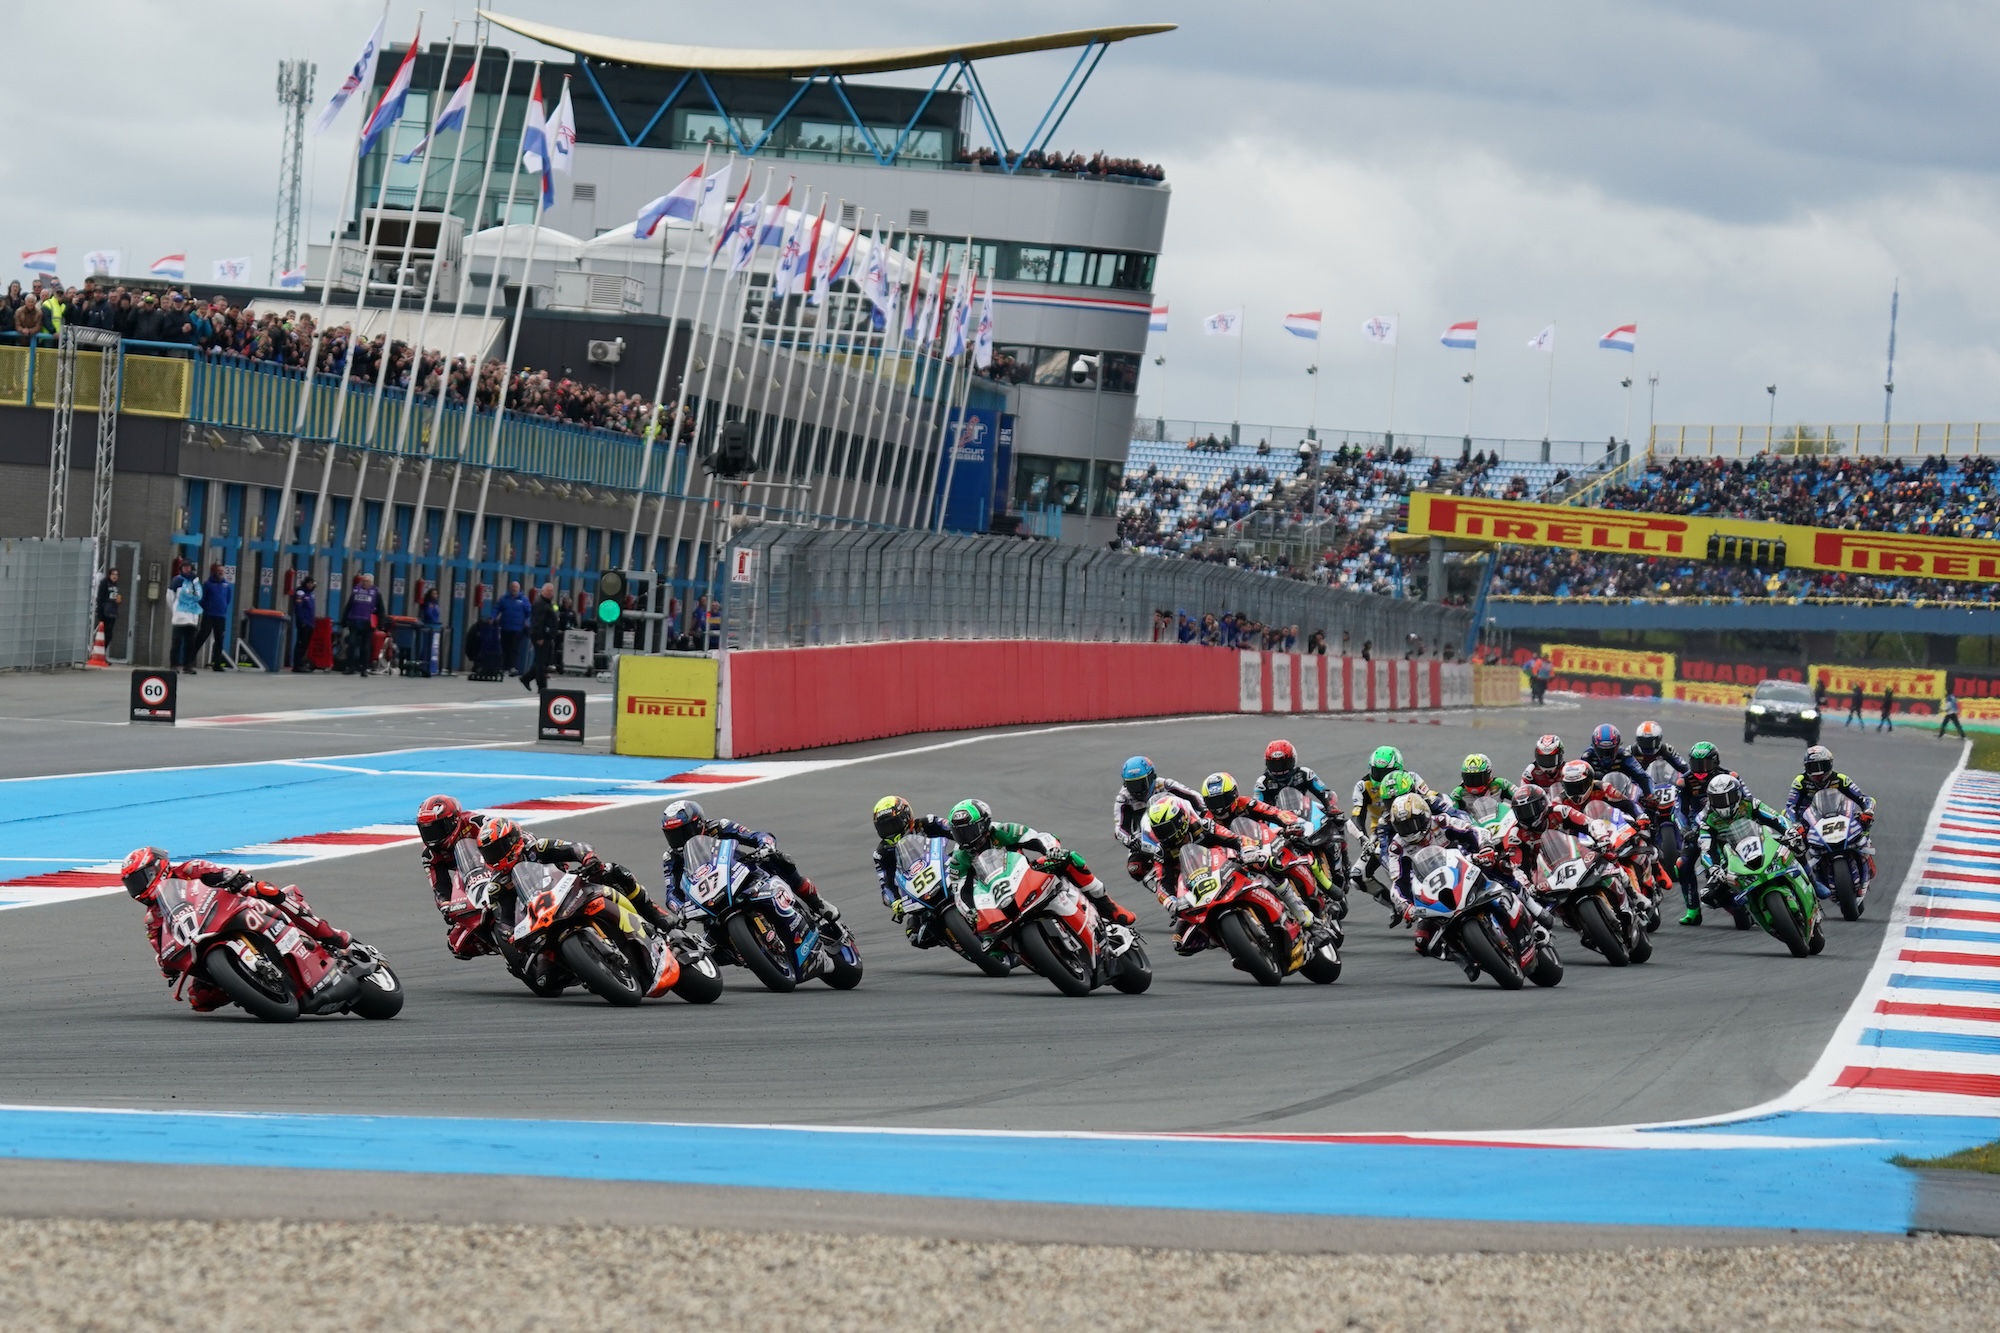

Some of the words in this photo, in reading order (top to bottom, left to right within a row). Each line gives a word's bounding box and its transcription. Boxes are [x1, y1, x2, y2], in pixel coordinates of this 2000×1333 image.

[949, 446, 985, 455] CRCUIT
[1428, 498, 1689, 553] PIRELLI
[1682, 660, 1803, 684] DIABLO
[1818, 669, 1936, 695] PIRELI
[145, 684, 163, 697] 60
[553, 704, 572, 716] 60
[627, 696, 707, 717] PIRELLI
[1822, 820, 1846, 837] 54
[697, 871, 720, 899] 97
[912, 866, 937, 894] 55
[1428, 872, 1447, 895] 9
[1555, 864, 1578, 887] 46
[471, 883, 488, 904] 7
[992, 880, 1012, 904] 22
[1193, 878, 1219, 904] 19
